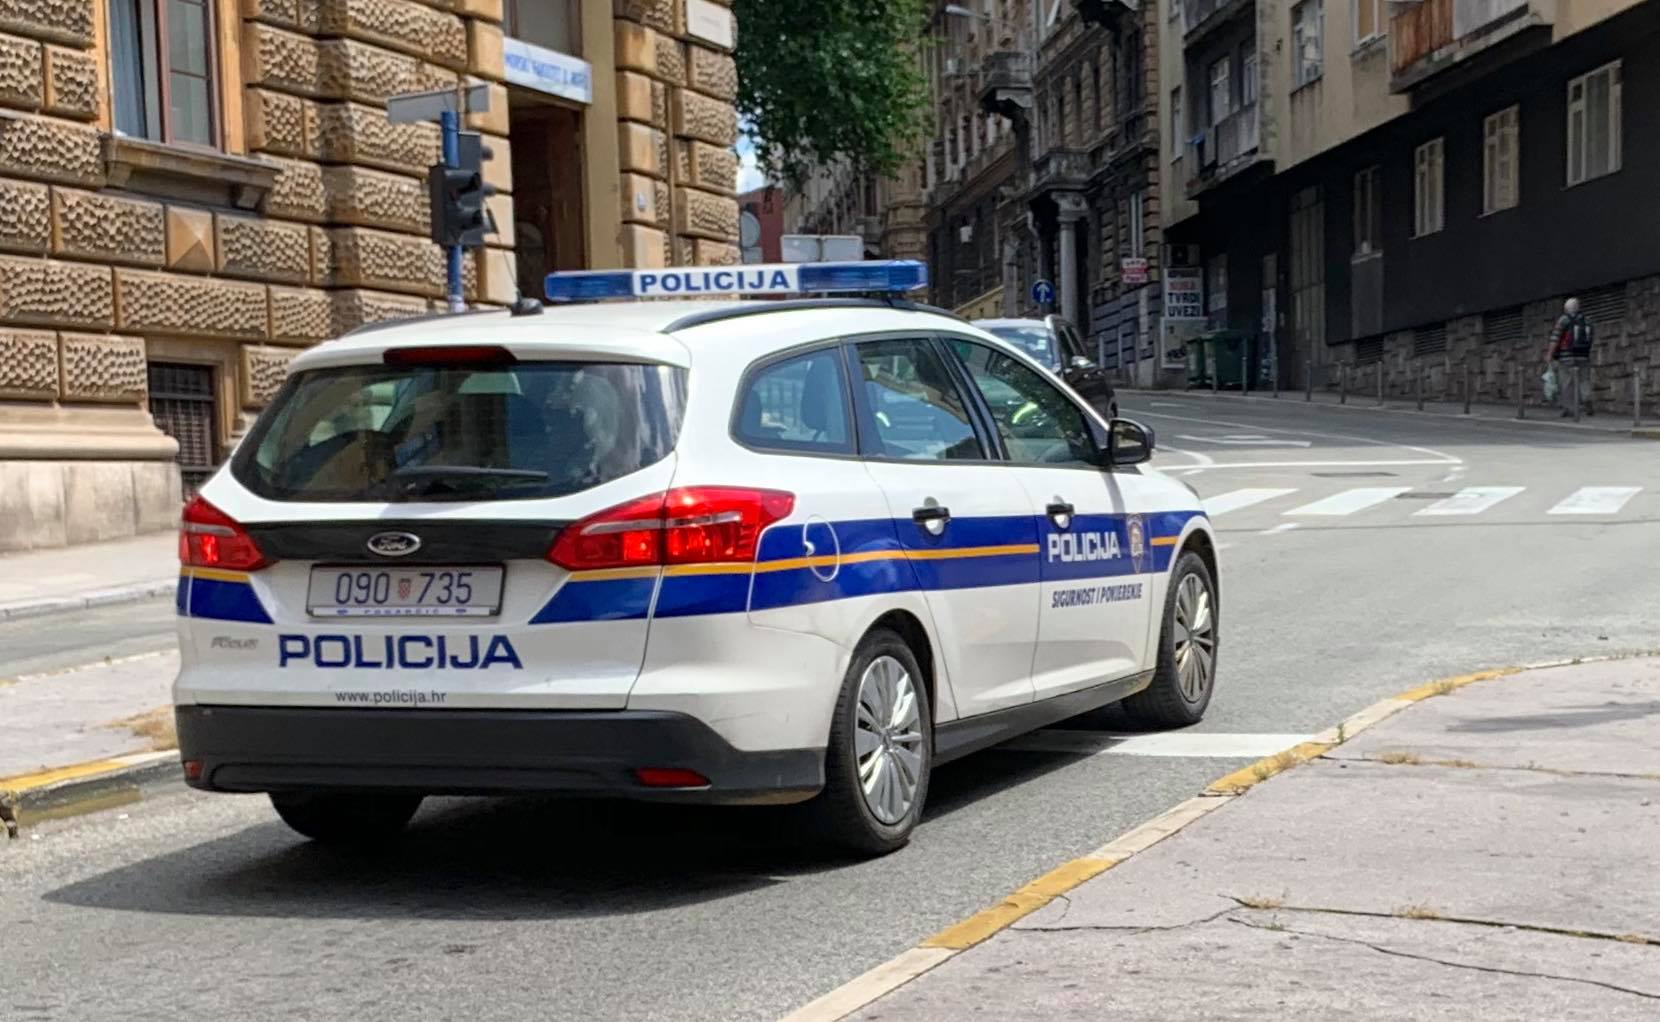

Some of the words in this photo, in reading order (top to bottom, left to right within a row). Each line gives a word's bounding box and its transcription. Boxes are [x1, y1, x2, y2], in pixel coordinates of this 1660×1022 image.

[640, 271, 788, 292] POLICIJA
[1047, 532, 1121, 562] POLICIJA
[335, 572, 391, 605] 090
[416, 571, 473, 605] 735
[1052, 588, 1095, 608] SIGURNOST
[277, 634, 524, 669] POLICIJA
[335, 689, 448, 707] www.policija.hr
